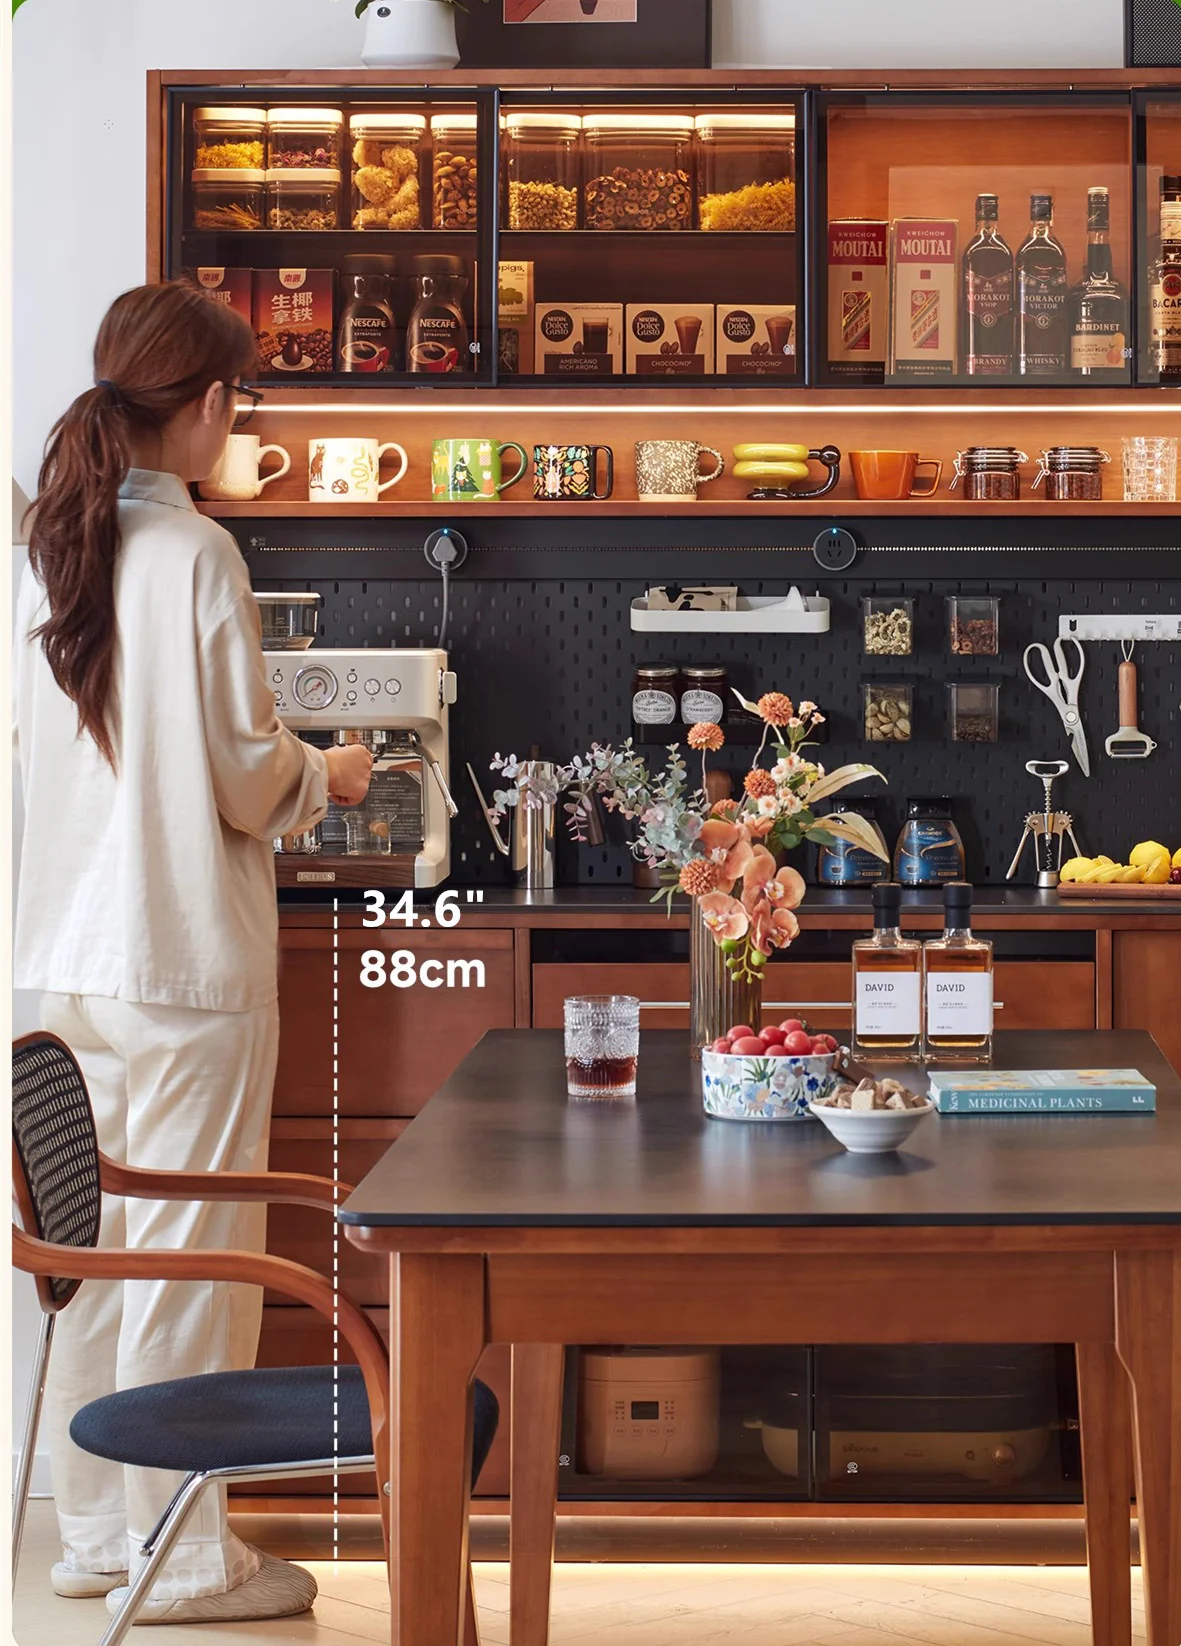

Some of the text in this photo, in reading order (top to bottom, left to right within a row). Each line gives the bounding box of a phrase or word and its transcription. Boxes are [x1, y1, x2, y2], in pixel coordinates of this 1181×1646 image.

[832, 241, 884, 257] MOUTAI
[900, 239, 952, 256] MOUTAI
[271, 291, 313, 310] 生椰
[271, 307, 313, 325] 拿铁
[545, 322, 569, 330] Dolce
[636, 322, 660, 330] Dolce
[727, 322, 751, 330] Dolce
[1075, 324, 1120, 332] BARDINET
[545, 328, 569, 336] Gusto
[636, 328, 660, 336] Gusto
[727, 328, 751, 336] Gusto
[865, 984, 895, 992] DAVID
[936, 984, 966, 992] DAVID
[968, 1097, 1103, 1109] MEDICINAL PLANTS
